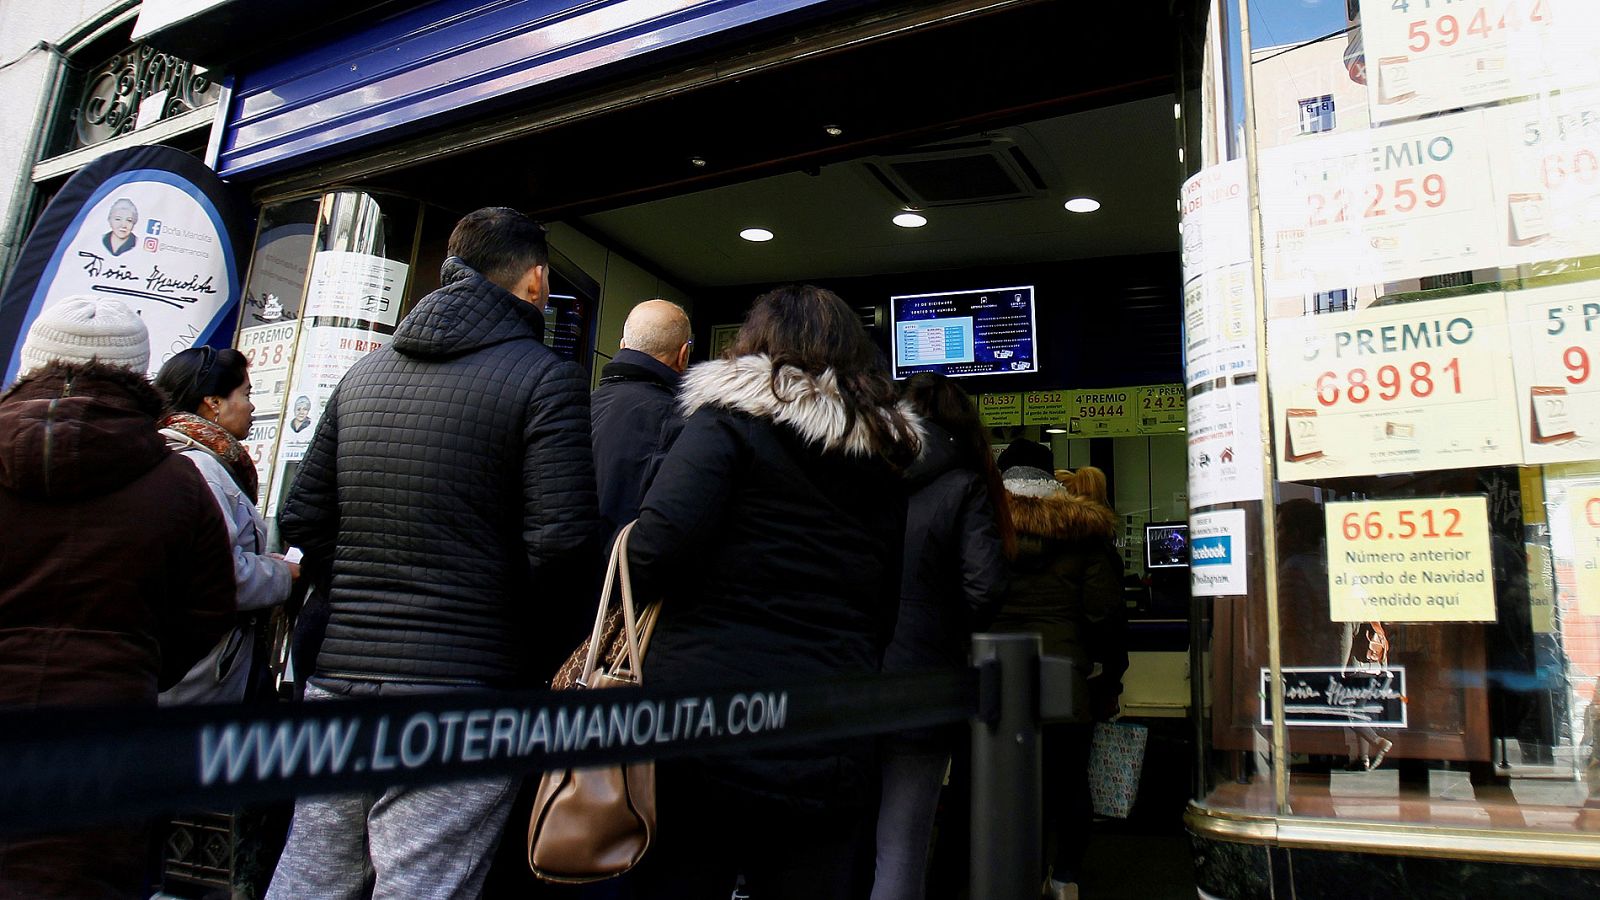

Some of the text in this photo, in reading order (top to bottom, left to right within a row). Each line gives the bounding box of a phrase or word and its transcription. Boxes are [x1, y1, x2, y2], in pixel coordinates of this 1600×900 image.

[1408, 1, 1552, 52] 59444
[1307, 173, 1447, 226] 22259
[252, 326, 294, 344] PREMIO
[1335, 317, 1473, 358] PREMIO
[1316, 357, 1463, 406] 68981
[983, 395, 1016, 405] 04.537
[1027, 393, 1062, 403] 66.512
[1086, 393, 1127, 404] PREMIO
[1079, 405, 1124, 418] 59444
[1342, 508, 1464, 541] 66.512
[1345, 548, 1471, 563] Número anterior
[1335, 572, 1348, 585] al
[1400, 571, 1417, 584] de
[1422, 569, 1485, 584] Navidad
[1361, 592, 1460, 608] vendido aquí
[199, 691, 789, 785] WWW.LOTERIAMANOLITA.COM
